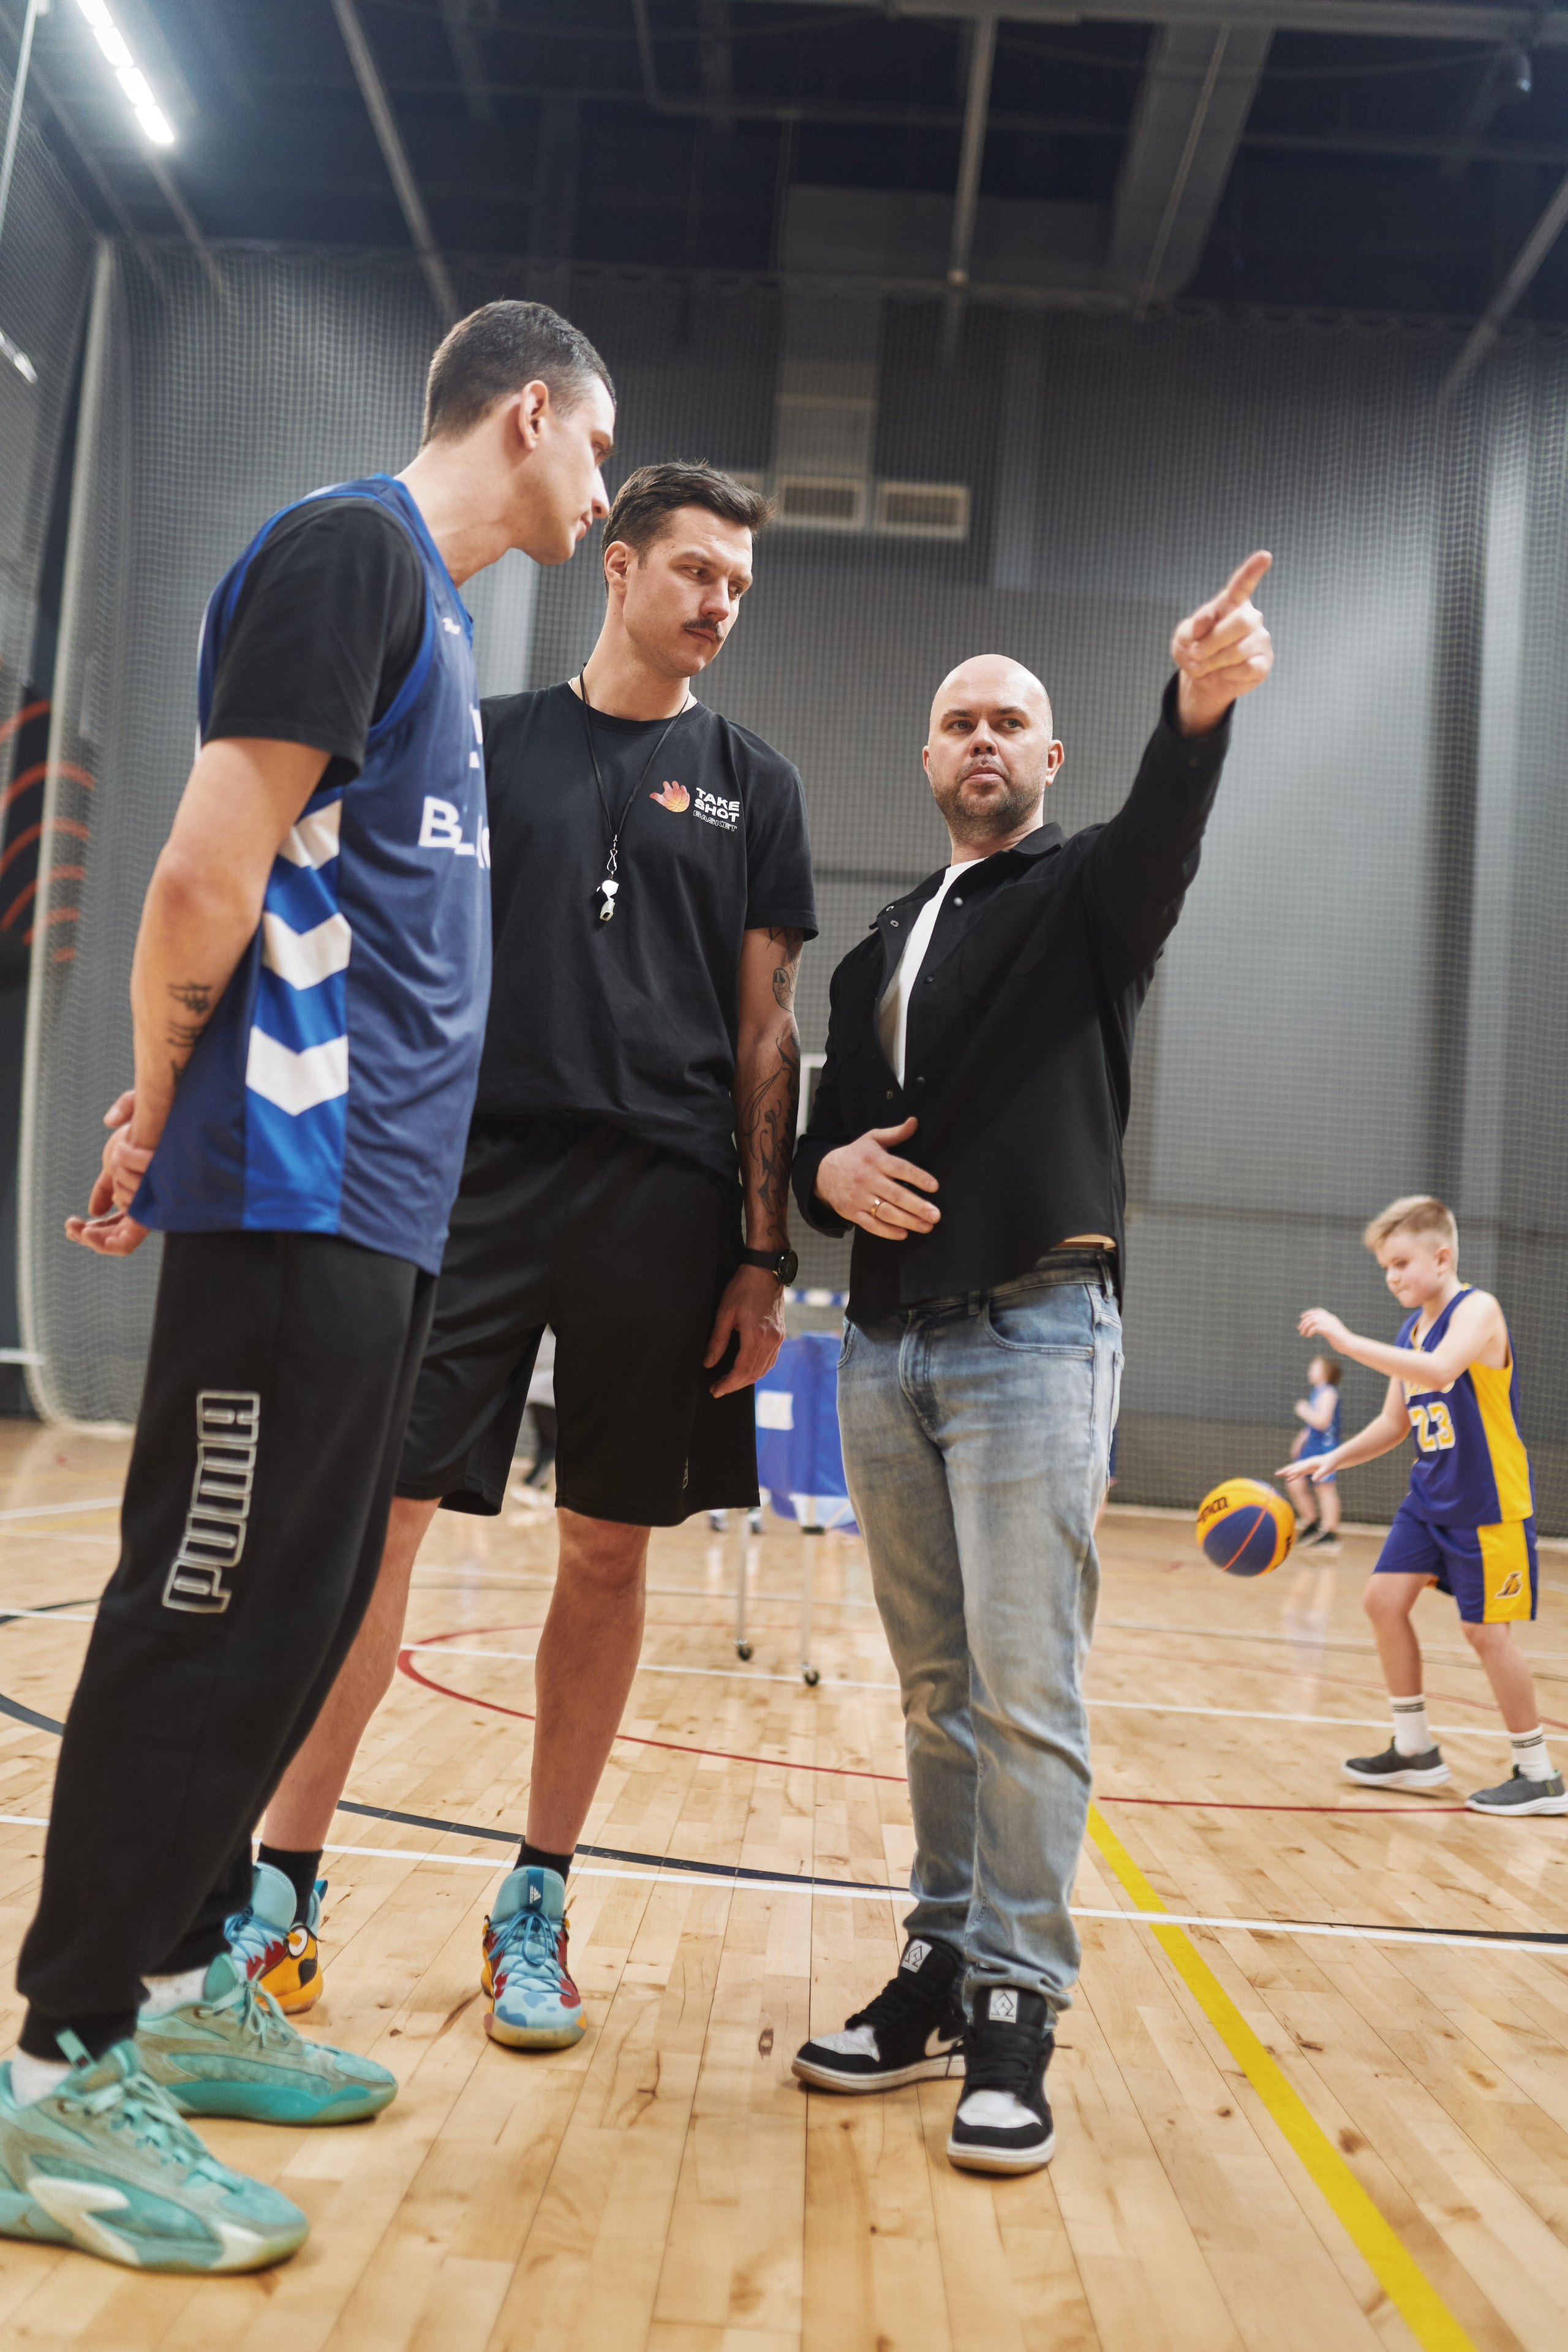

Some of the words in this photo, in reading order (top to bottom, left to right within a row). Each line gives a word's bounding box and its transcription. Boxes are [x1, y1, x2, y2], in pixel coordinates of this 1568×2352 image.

[694, 798, 740, 823] SHOT
[696, 787, 740, 812] TAKE
[693, 810, 737, 832] BASKET
[1408, 1401, 1456, 1452] 23
[162, 1390, 260, 1613] PUMA
